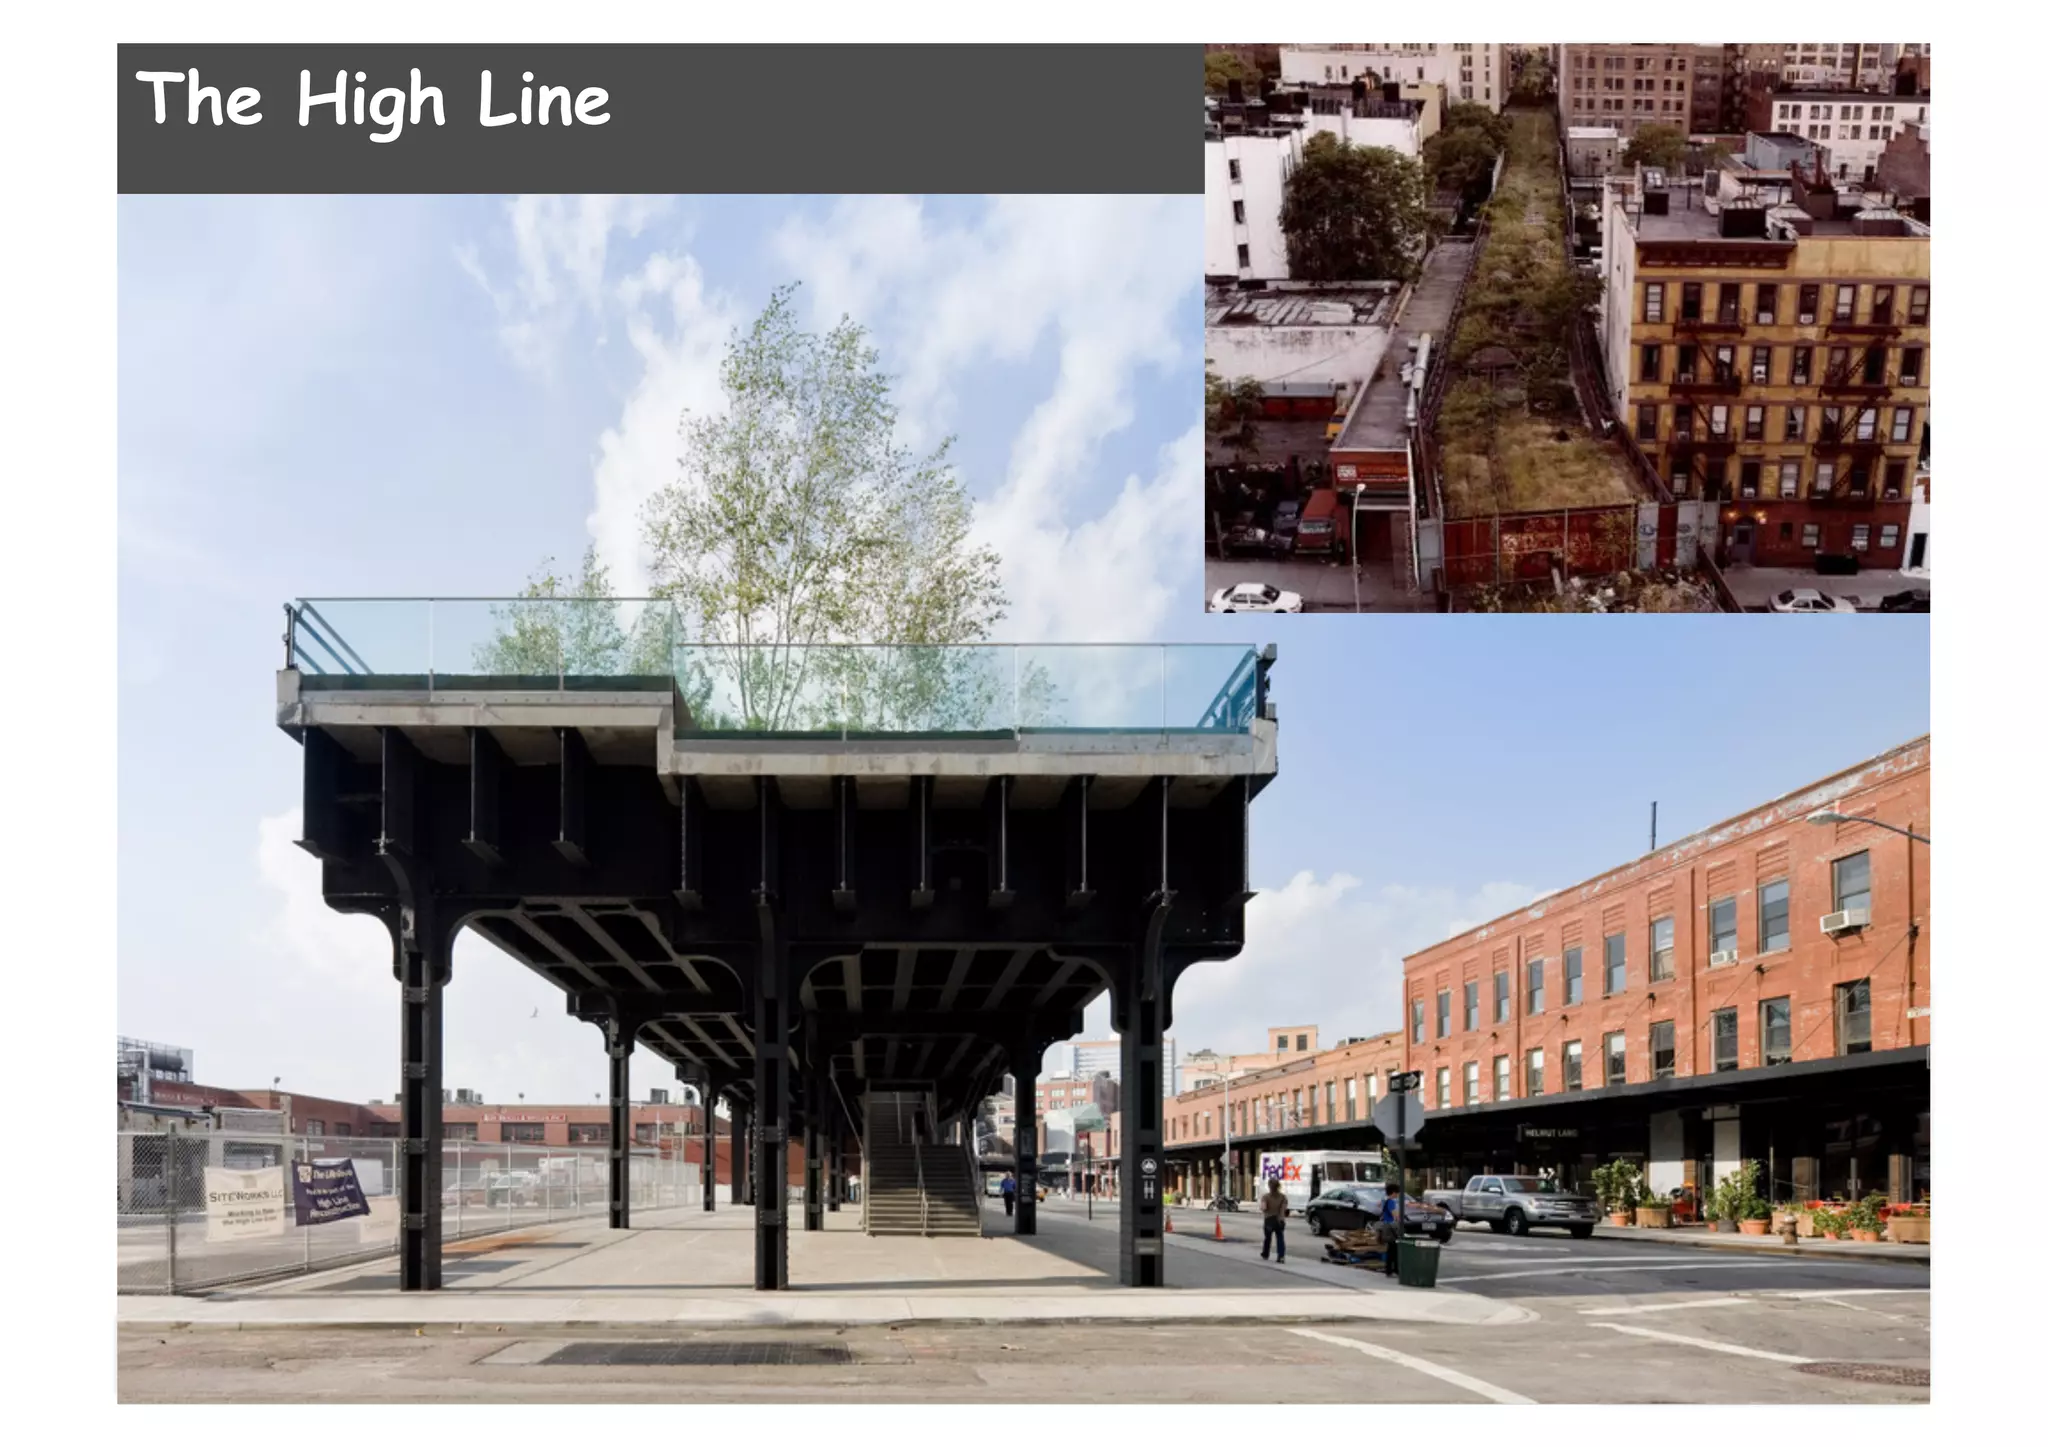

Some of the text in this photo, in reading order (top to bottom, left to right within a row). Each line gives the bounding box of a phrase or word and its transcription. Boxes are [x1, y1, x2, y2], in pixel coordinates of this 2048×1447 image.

[1525, 1128, 1578, 1138] HELMUT LANG
[1262, 1156, 1302, 1181] FedEx
